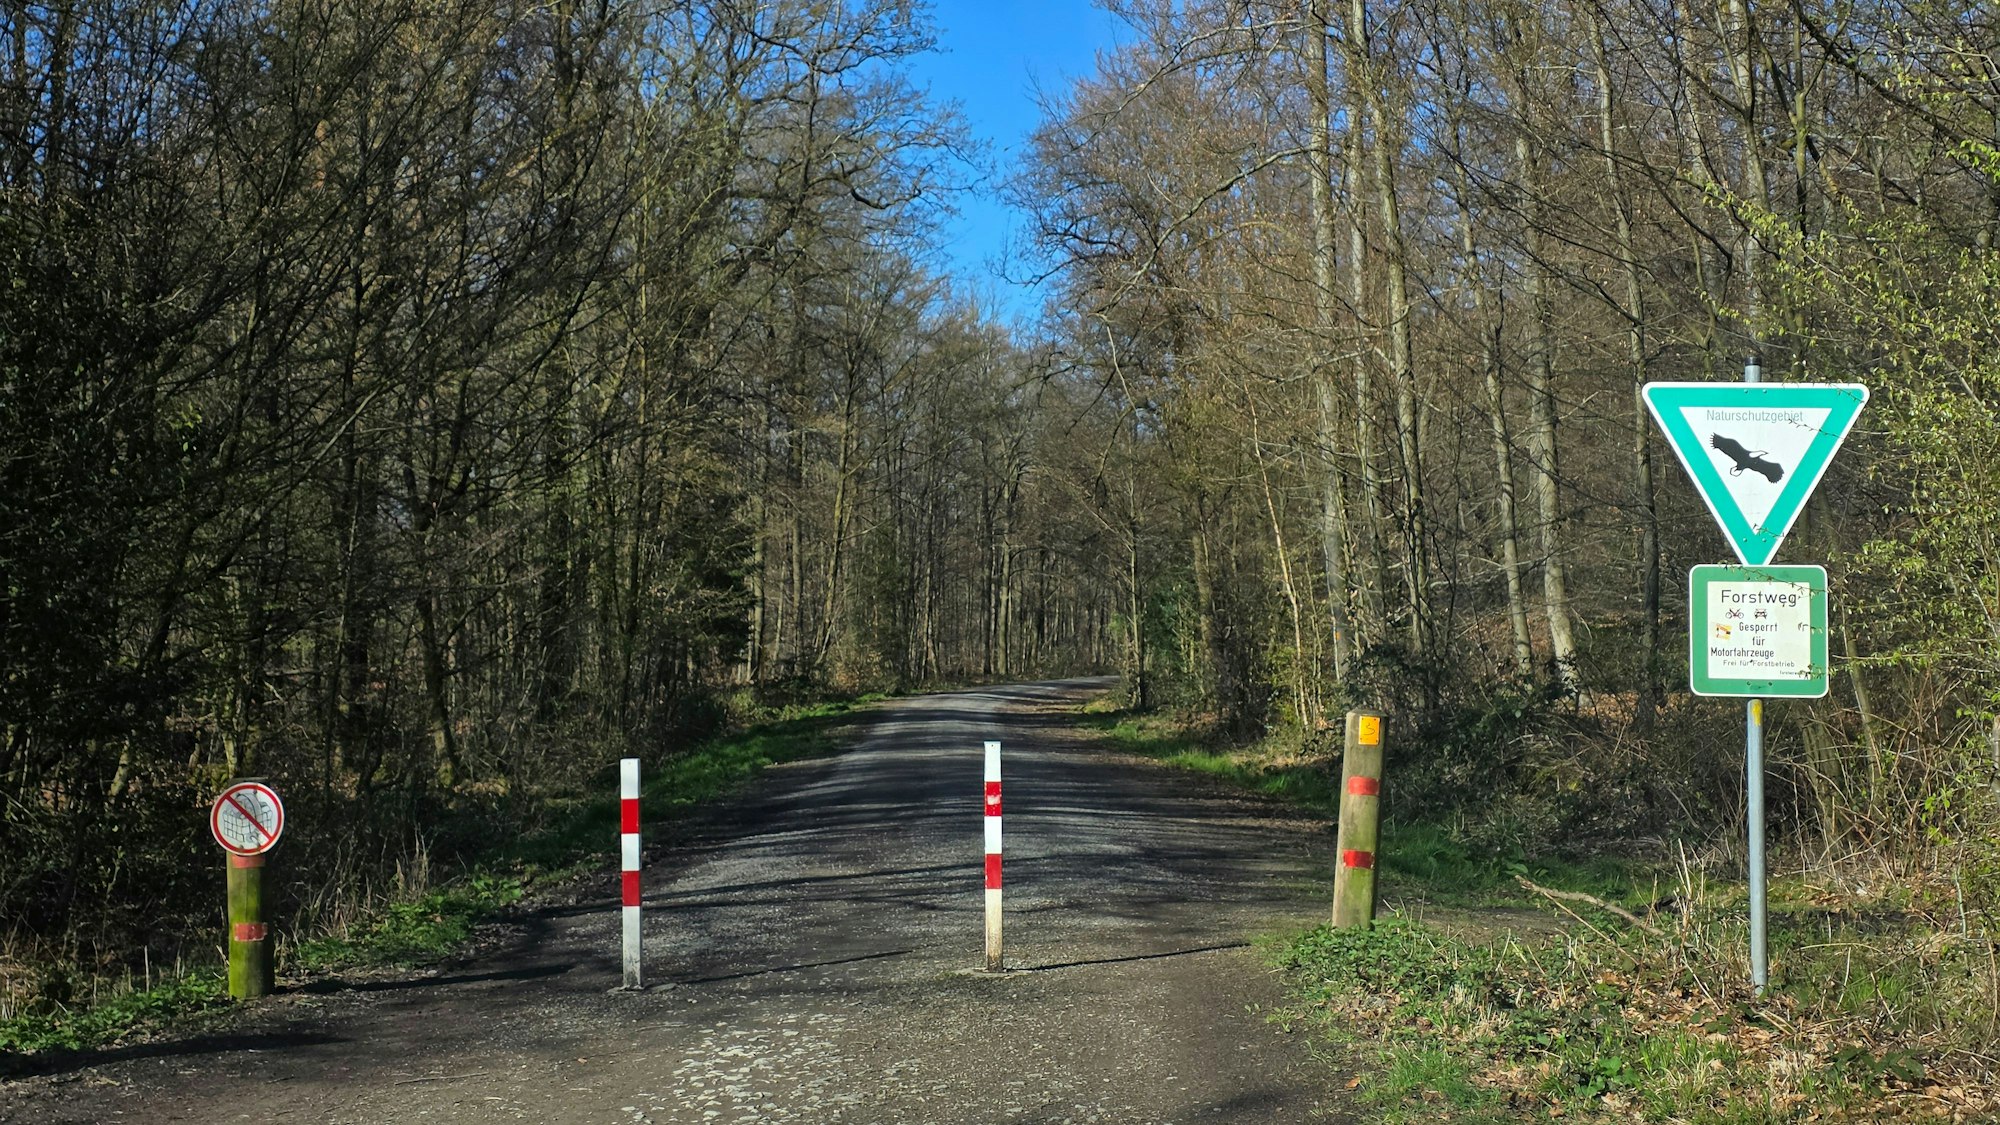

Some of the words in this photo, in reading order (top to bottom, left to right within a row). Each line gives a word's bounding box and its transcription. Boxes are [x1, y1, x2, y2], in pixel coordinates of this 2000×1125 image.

[1706, 409, 1803, 424] Naturschutzgebiet
[1721, 589, 1797, 607] Forstweg
[1739, 622, 1778, 633] Gesperrt
[1752, 636, 1765, 646] für
[1710, 647, 1775, 659] Motorfahrzeuge
[1752, 660, 1795, 668] Forstbetrieb
